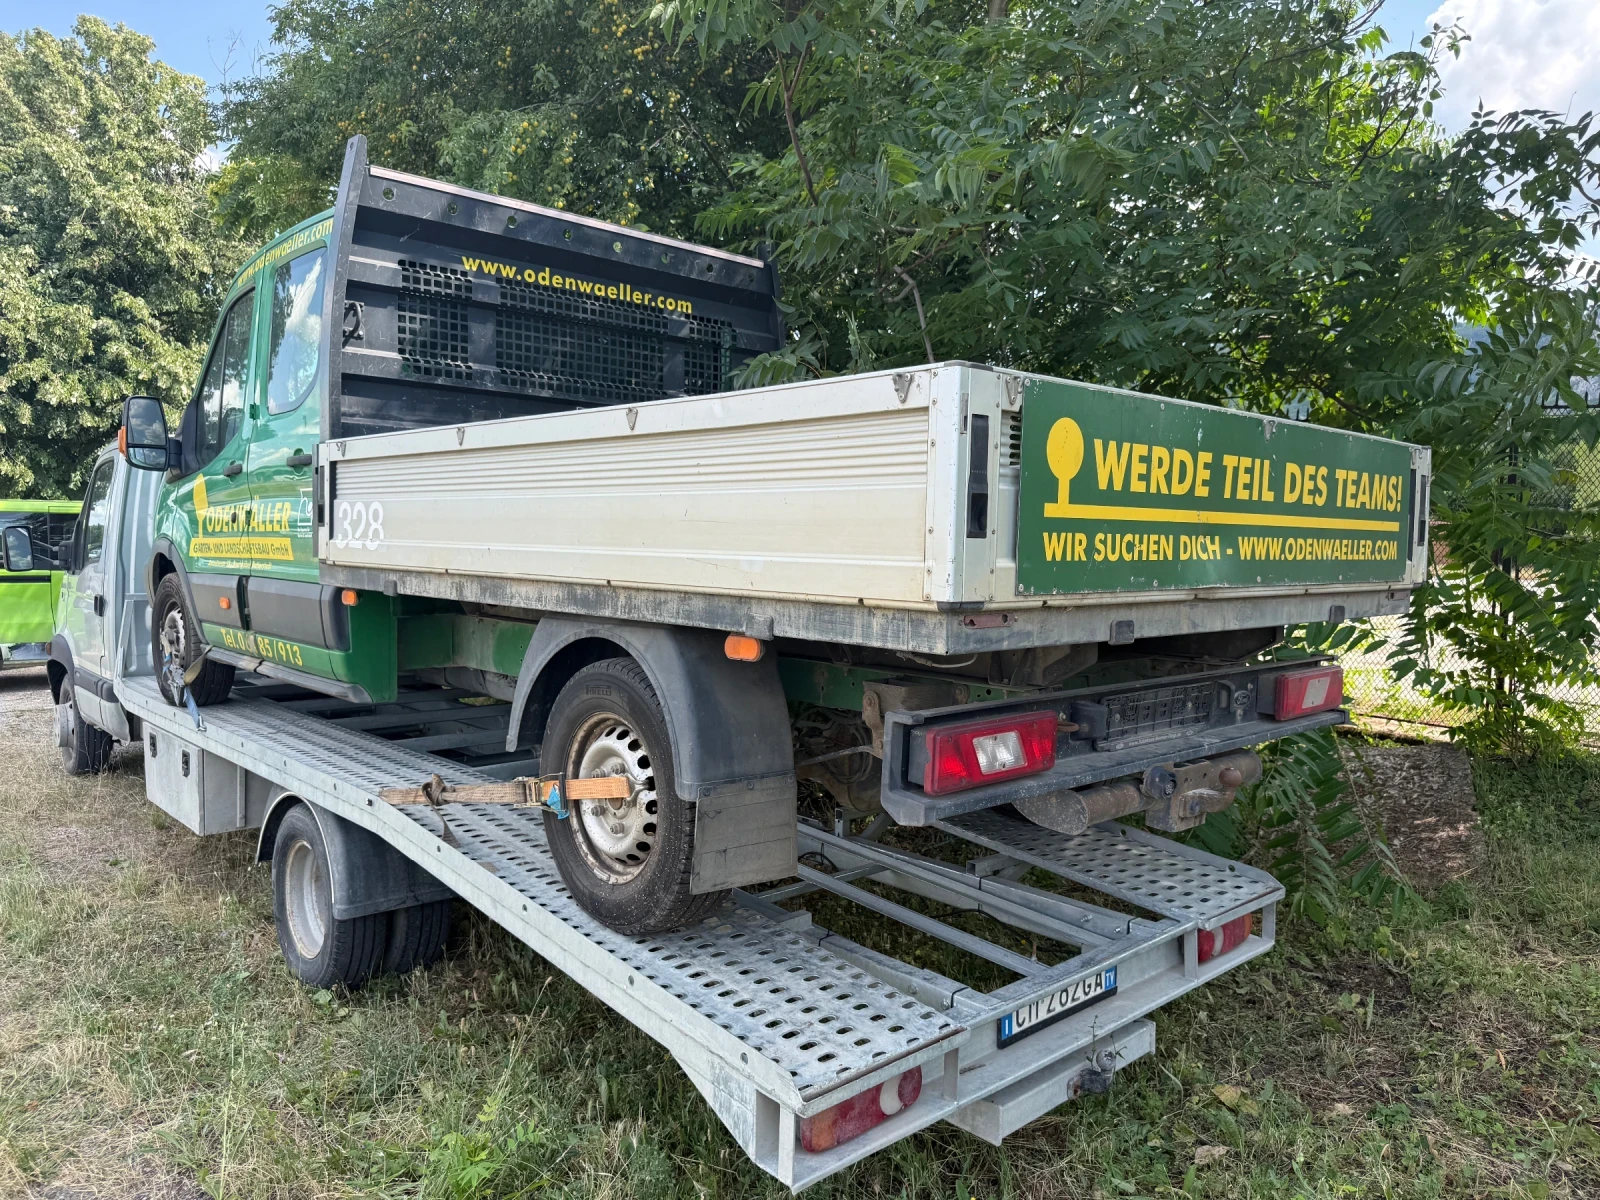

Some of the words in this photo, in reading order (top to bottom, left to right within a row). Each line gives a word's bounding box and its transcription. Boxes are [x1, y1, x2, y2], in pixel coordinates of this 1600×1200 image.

[462, 255, 693, 314] www.odenwaeller.com
[1093, 438, 1213, 498] WERDE
[1222, 455, 1274, 502] TEIL
[1283, 462, 1328, 507] DES
[1335, 469, 1403, 513] TEAMS!
[213, 542, 223, 554] UND
[223, 542, 270, 556] LANDSCHAFTSBAU
[270, 543, 290, 557] GmbH
[336, 501, 384, 550] 328
[1042, 532, 1087, 562] WIR
[1093, 532, 1173, 562] SUCHEN
[1179, 535, 1221, 561] DICH
[1238, 536, 1398, 561] WWW.ODENWAELLER.COM
